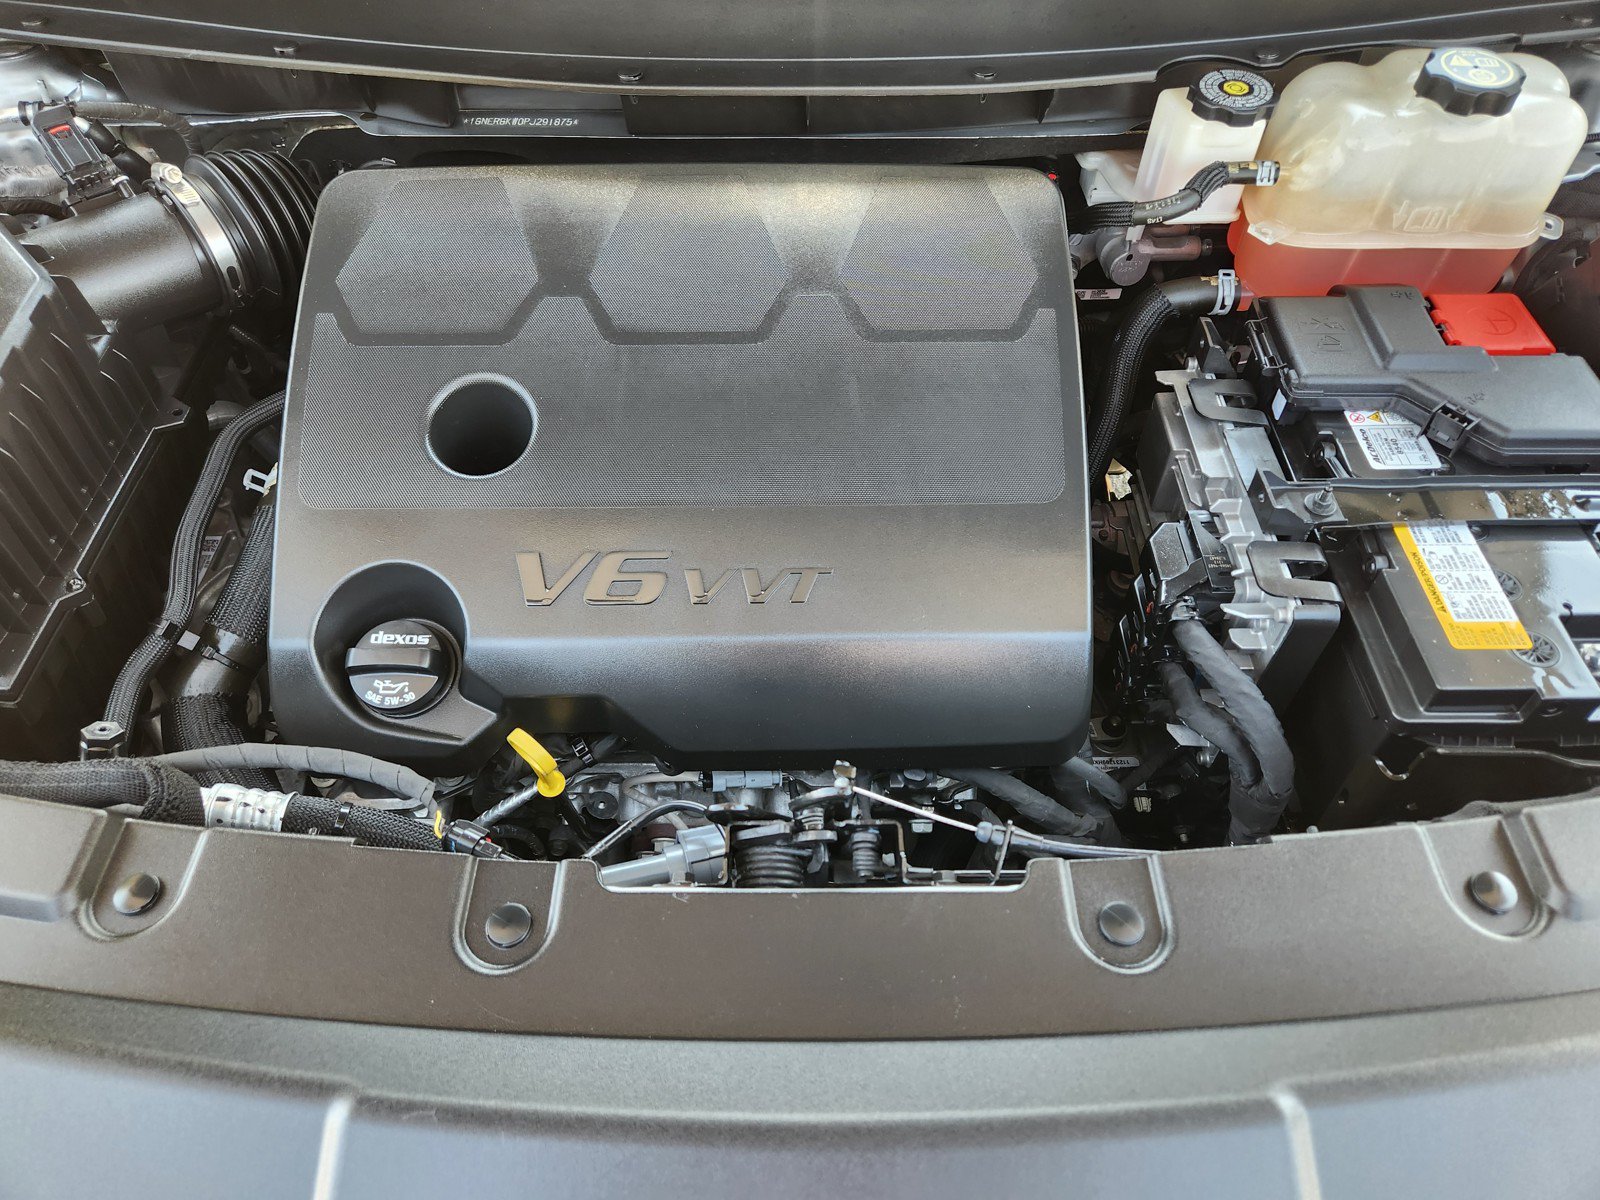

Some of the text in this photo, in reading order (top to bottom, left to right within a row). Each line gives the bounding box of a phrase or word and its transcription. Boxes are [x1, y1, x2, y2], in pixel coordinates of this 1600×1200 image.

[1360, 429, 1382, 464] ACDelco
[515, 551, 834, 607] V6 VVT
[370, 631, 431, 645] dexos
[365, 690, 416, 705] SAE 5W-30
